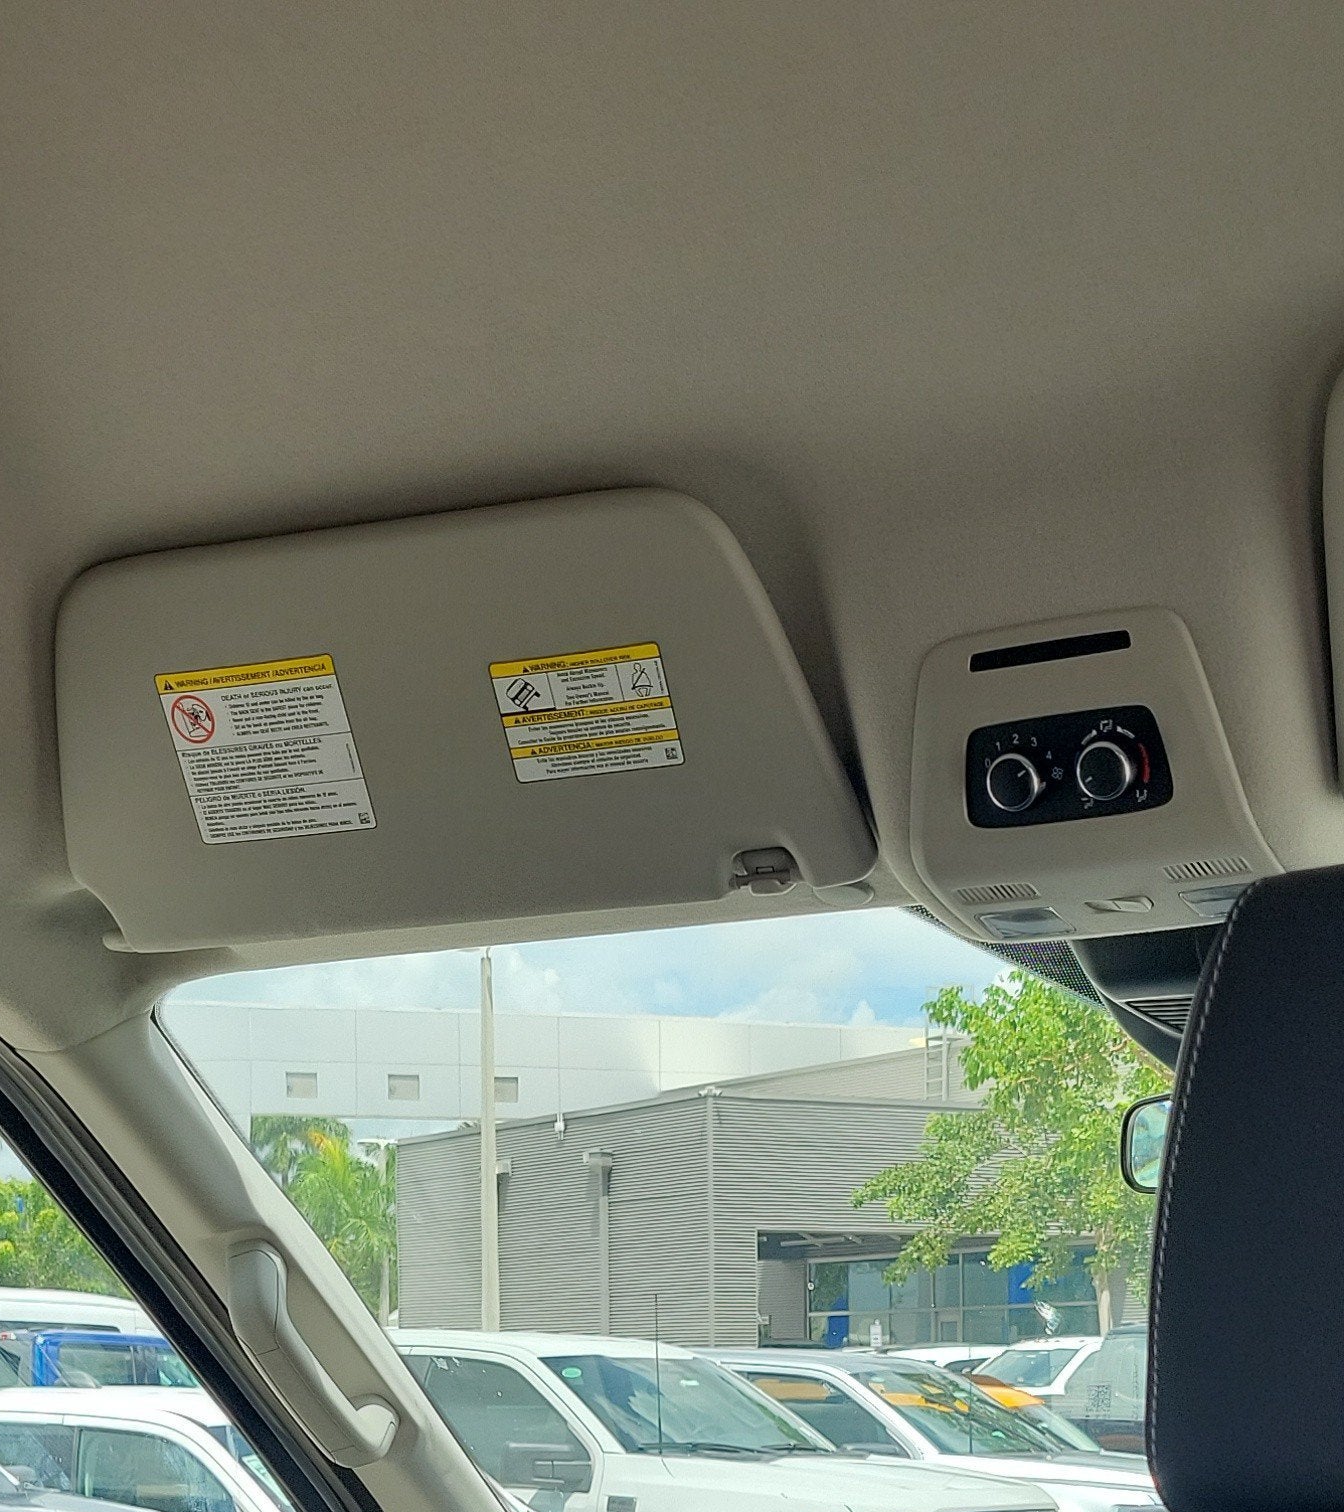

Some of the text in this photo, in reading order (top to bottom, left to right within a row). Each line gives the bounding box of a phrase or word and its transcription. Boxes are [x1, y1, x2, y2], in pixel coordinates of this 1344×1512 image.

[174, 677, 209, 688] WARNING
[219, 692, 242, 702] DEATH
[249, 688, 278, 698] SERIOUS
[278, 685, 302, 695] INJURY
[302, 684, 314, 692] can
[1012, 733, 1019, 744] 2
[1030, 737, 1037, 747] 3
[995, 741, 1001, 751] 1
[1045, 750, 1052, 760] 4
